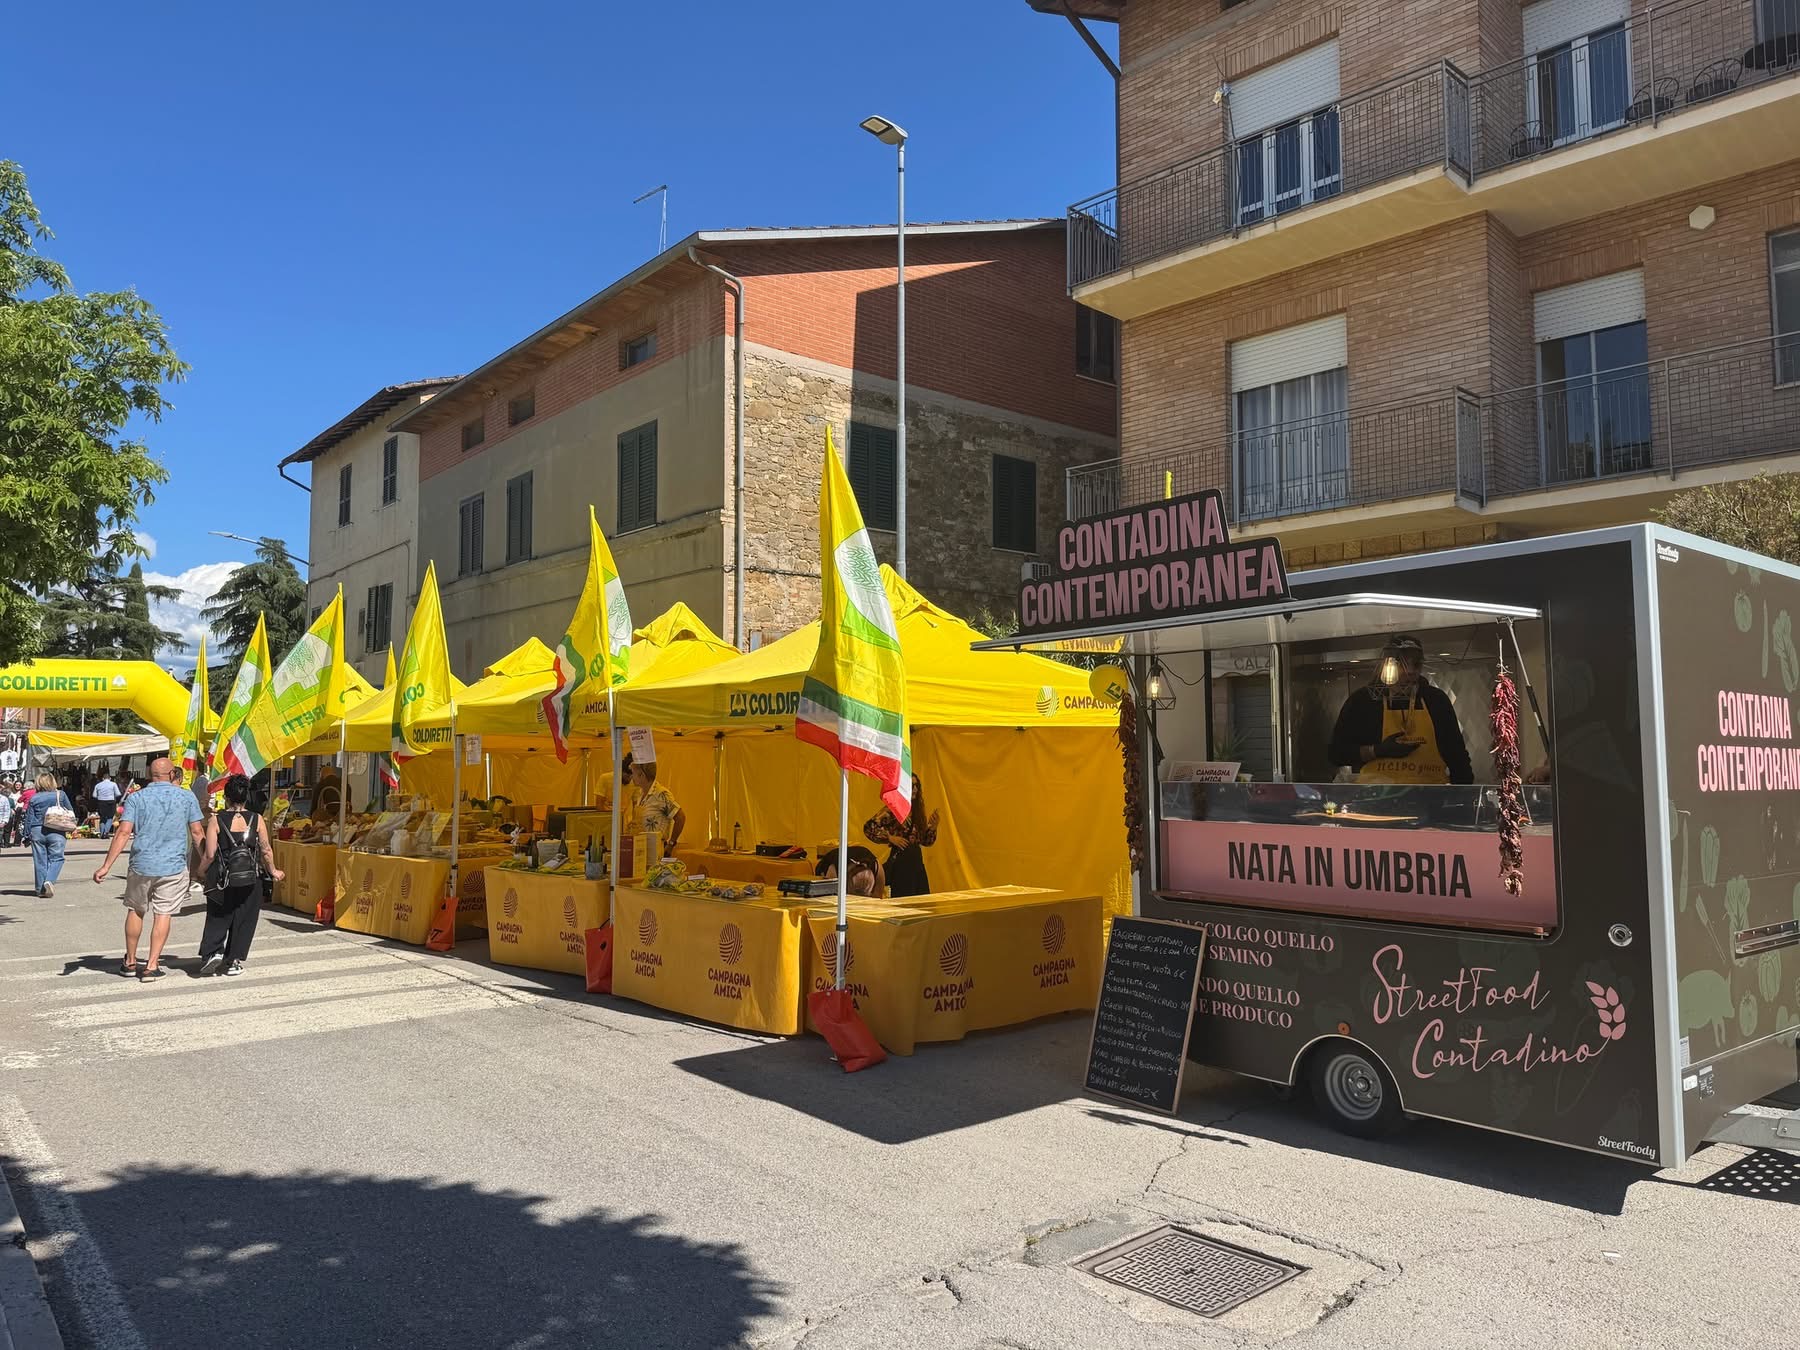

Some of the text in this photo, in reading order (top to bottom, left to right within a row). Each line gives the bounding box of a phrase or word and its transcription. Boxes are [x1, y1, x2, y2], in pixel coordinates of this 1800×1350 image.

[1059, 496, 1225, 571] CONTADINA
[1022, 545, 1284, 627] CONTEMPORANEA
[0, 675, 107, 692] COLDIRETTI
[585, 702, 608, 714] AMICA
[750, 691, 803, 715] COLDIR
[1718, 690, 1792, 739] CONTADINA
[413, 727, 452, 743] COLDIRETTI
[1196, 769, 1230, 777] CAMPAGNA
[1228, 841, 1472, 898] NATA IN UMBRIA
[497, 921, 523, 935] CAMPAGNA
[501, 933, 519, 944] AMICA
[1175, 918, 1335, 952] COLGO QUELLO
[630, 949, 663, 967] CAMPAGNA
[1210, 944, 1273, 968] SEMINO
[635, 964, 656, 978] AMICA
[708, 968, 751, 988] CAMPAGNA
[1033, 959, 1076, 977] CAMPAGNA
[816, 976, 870, 998] CAMGNA
[923, 977, 974, 999] CAMPANA
[1040, 973, 1069, 989] AMICA
[713, 984, 742, 1001] AMICA
[1233, 981, 1300, 1007] QUELLO
[935, 997, 967, 1012] AMIC
[1212, 1000, 1292, 1029] PRODUCO
[1412, 1018, 1604, 1079] Contadino
[1598, 1135, 1656, 1160] StreetFoody
